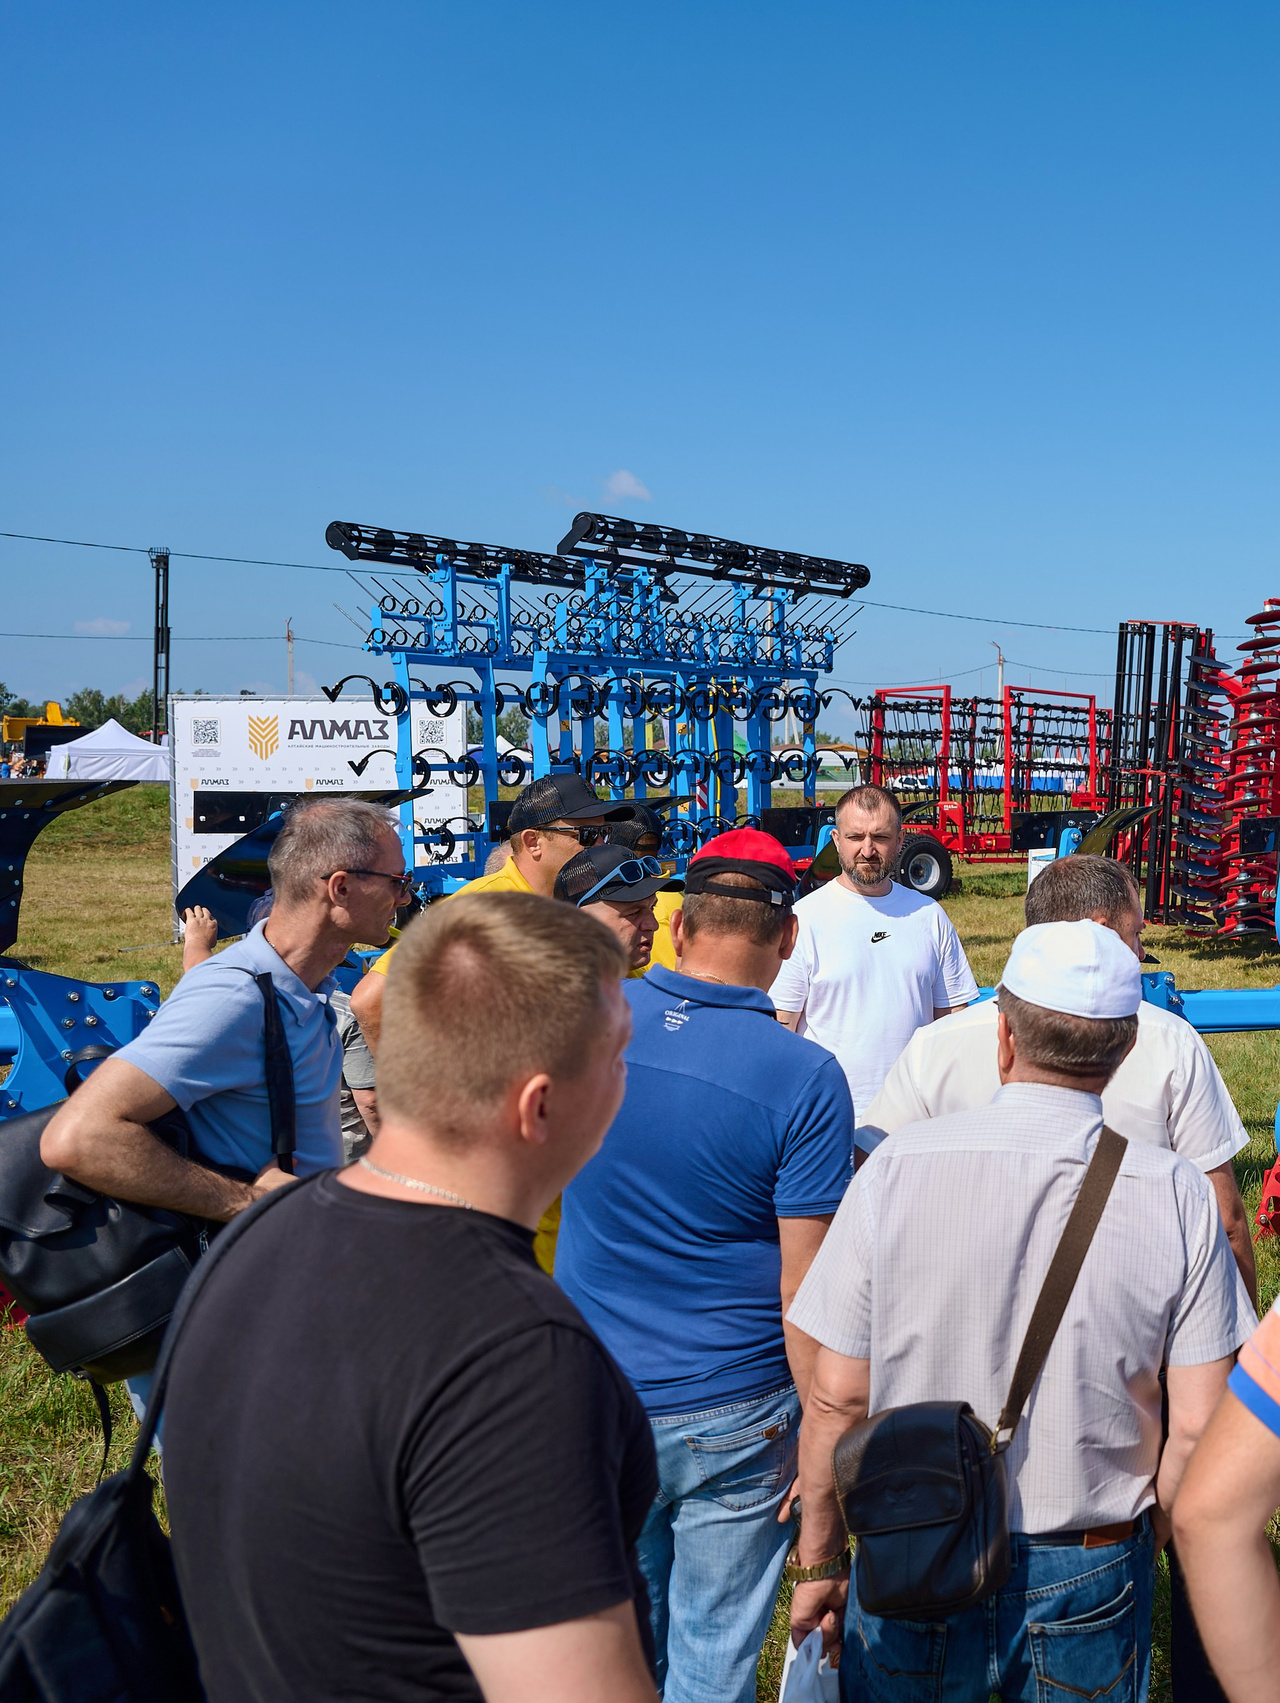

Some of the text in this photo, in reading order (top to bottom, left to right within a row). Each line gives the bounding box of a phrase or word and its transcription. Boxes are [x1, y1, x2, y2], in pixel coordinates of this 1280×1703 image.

[288, 719, 390, 740] АЛМАЗ
[429, 778, 453, 786] АЛМА
[665, 1010, 690, 1021] ORIGINAL
